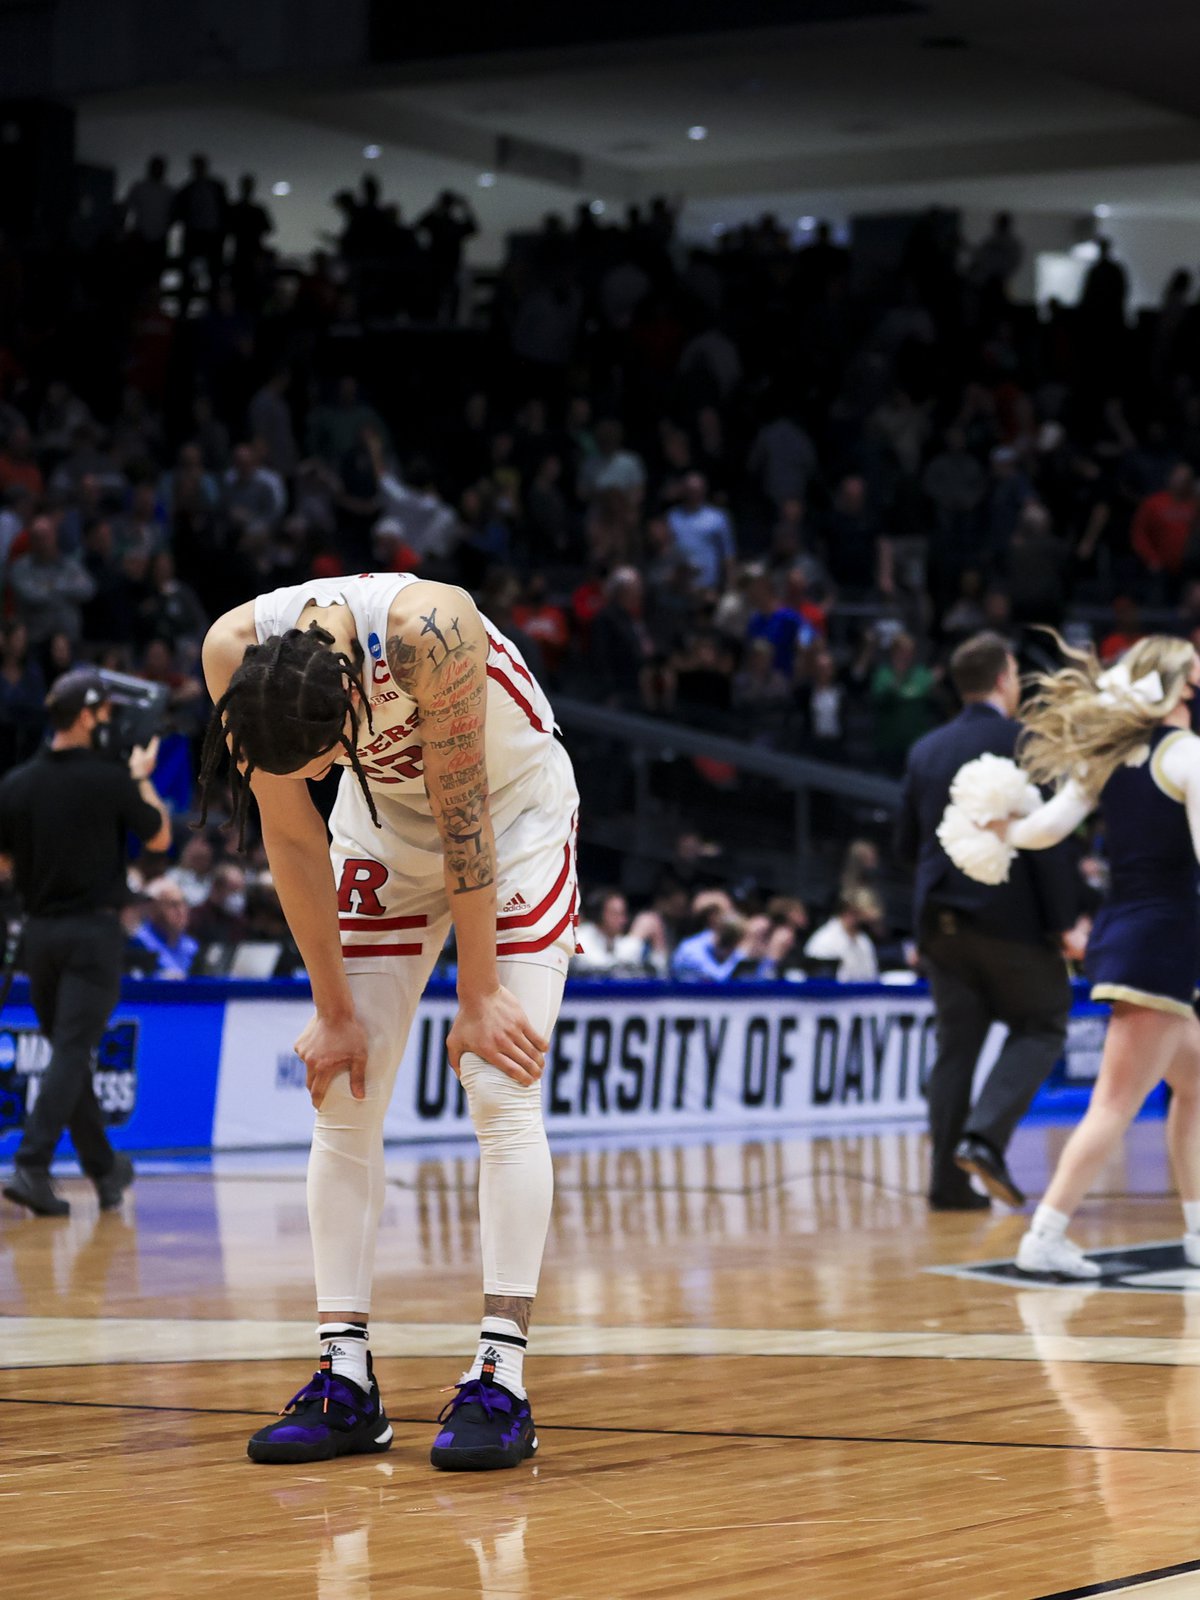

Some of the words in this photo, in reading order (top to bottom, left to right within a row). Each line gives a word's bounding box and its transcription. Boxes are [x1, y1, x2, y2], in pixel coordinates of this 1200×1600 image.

[373, 660, 390, 684] C
[337, 858, 389, 917] R
[503, 903, 532, 913] adidas
[741, 1013, 799, 1110] OF
